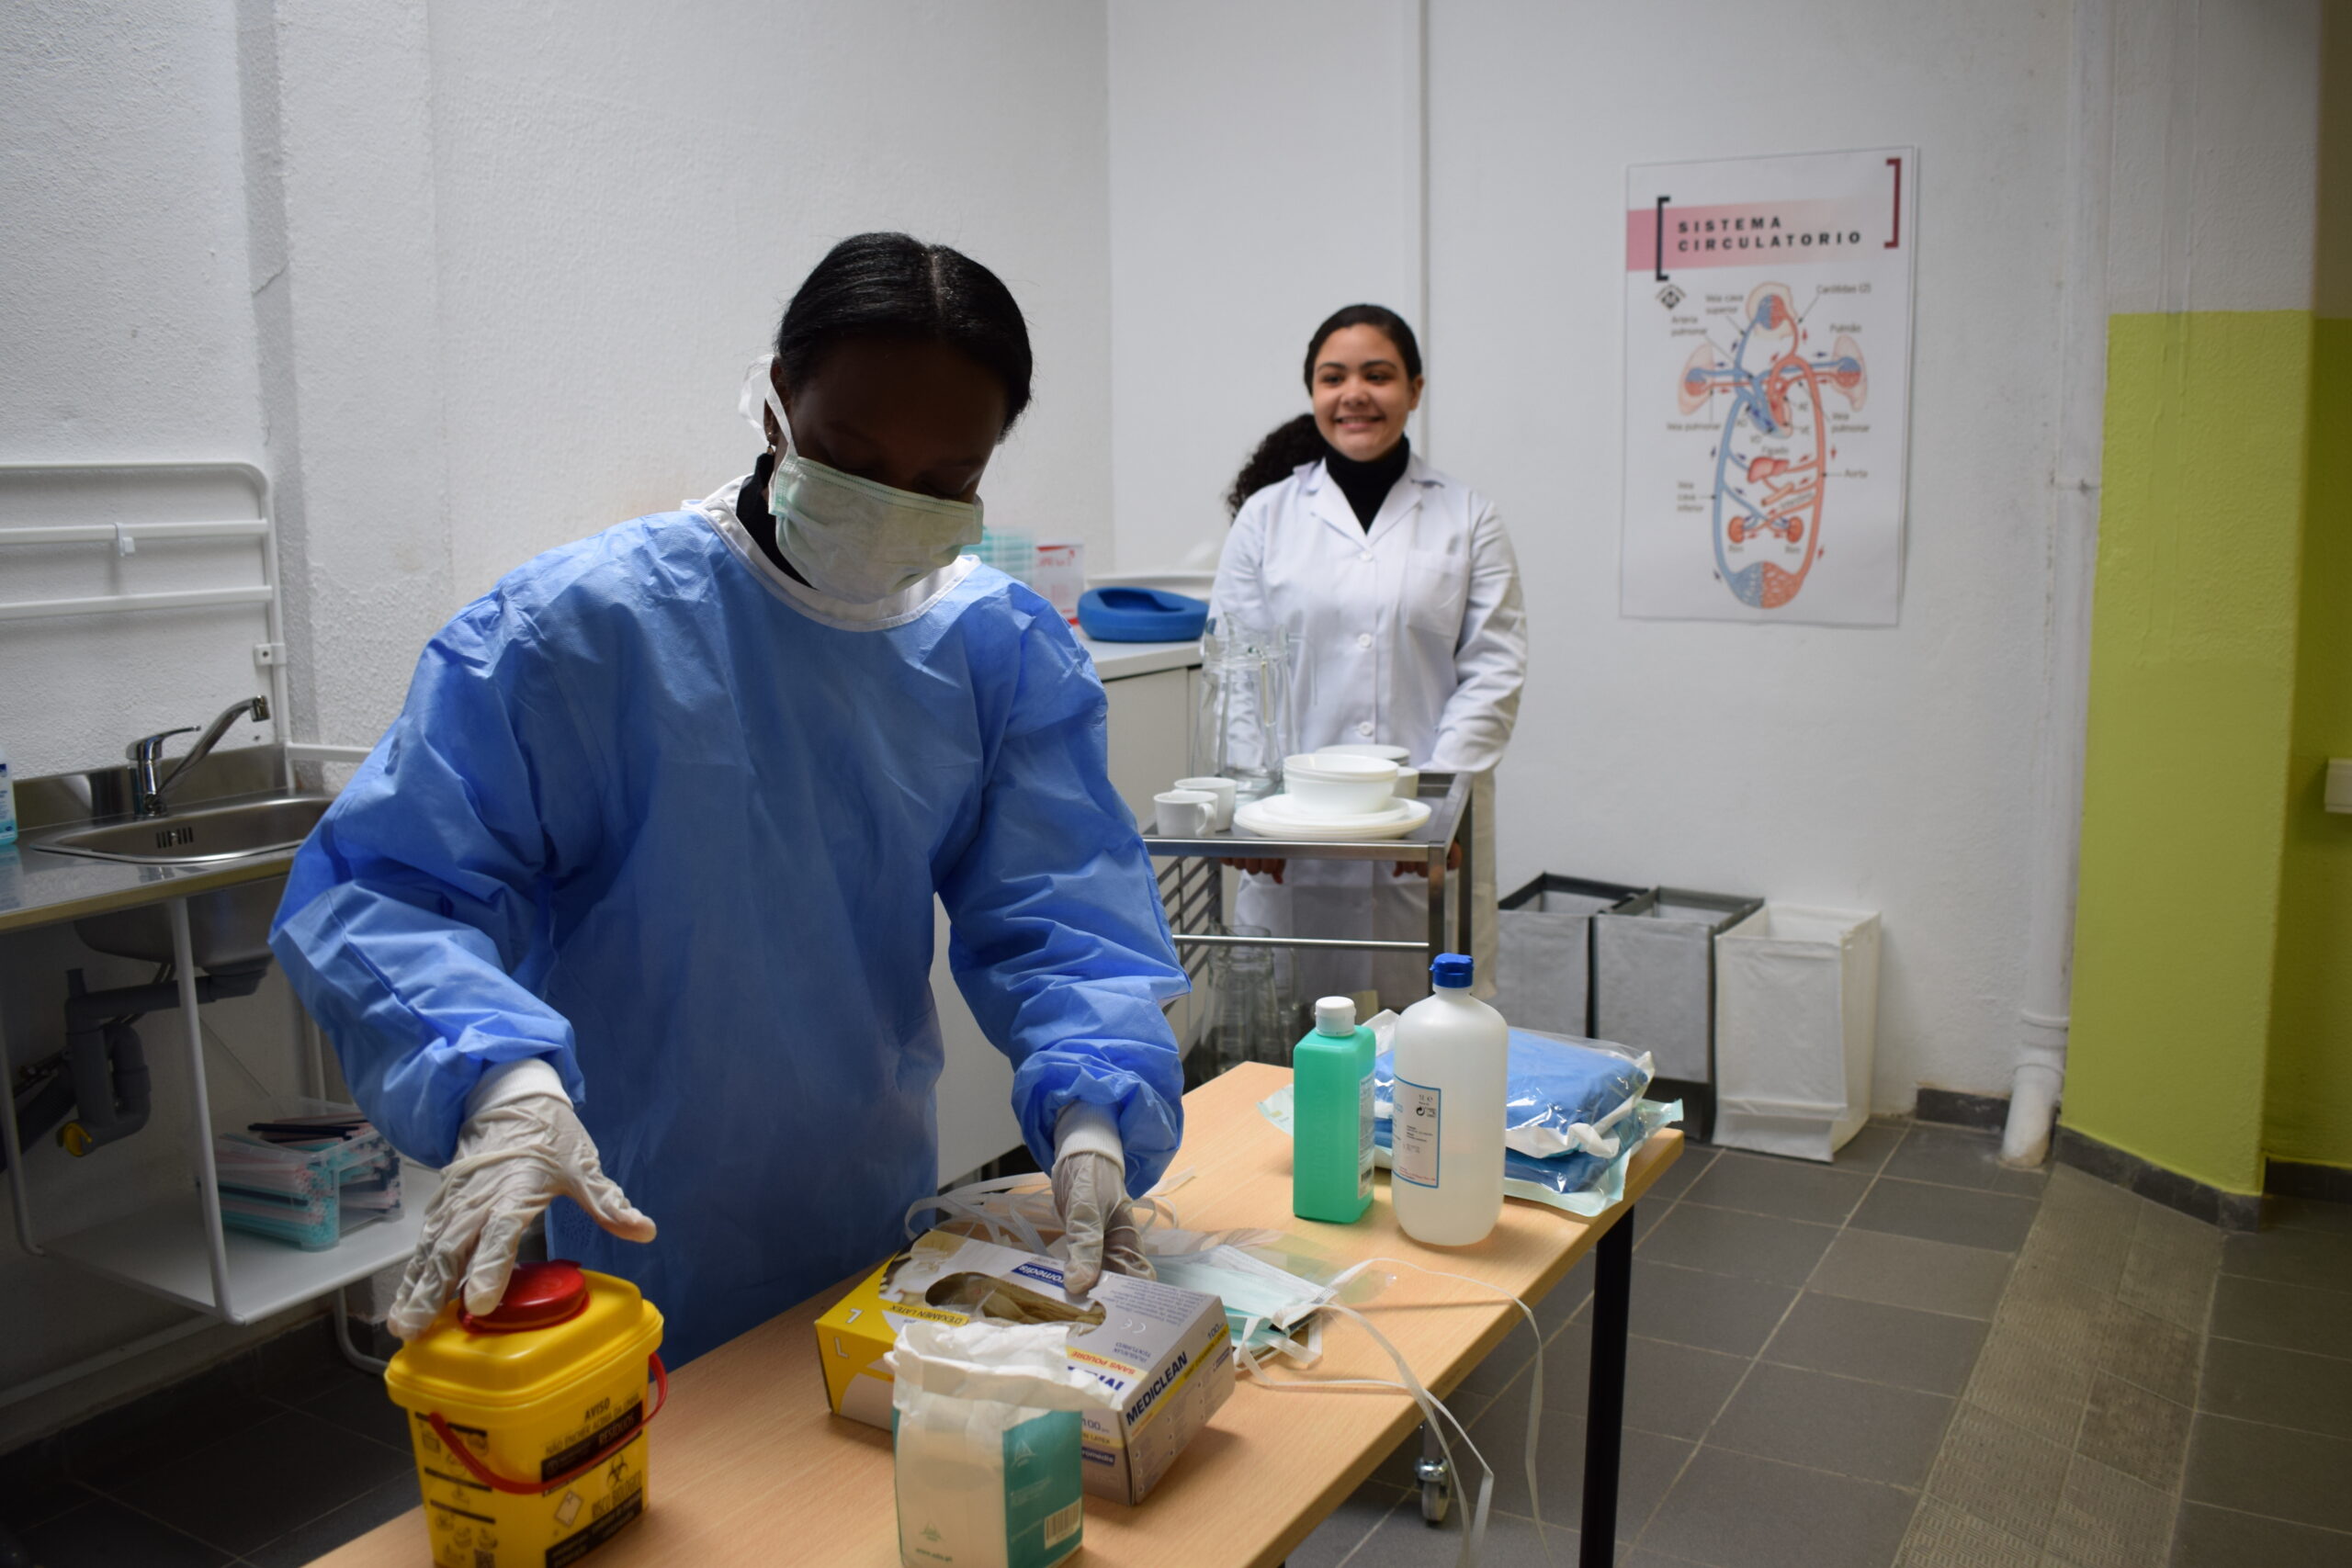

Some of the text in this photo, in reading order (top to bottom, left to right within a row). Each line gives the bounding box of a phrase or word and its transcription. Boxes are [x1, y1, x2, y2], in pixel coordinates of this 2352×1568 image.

[1678, 216, 1781, 233] SISTEMA
[1018, 1265, 1066, 1284] romedis
[845, 1307, 865, 1324] L
[834, 1337, 850, 1360] L
[1125, 1351, 1189, 1426] MEDICLEAN
[584, 1396, 610, 1423] AVISO
